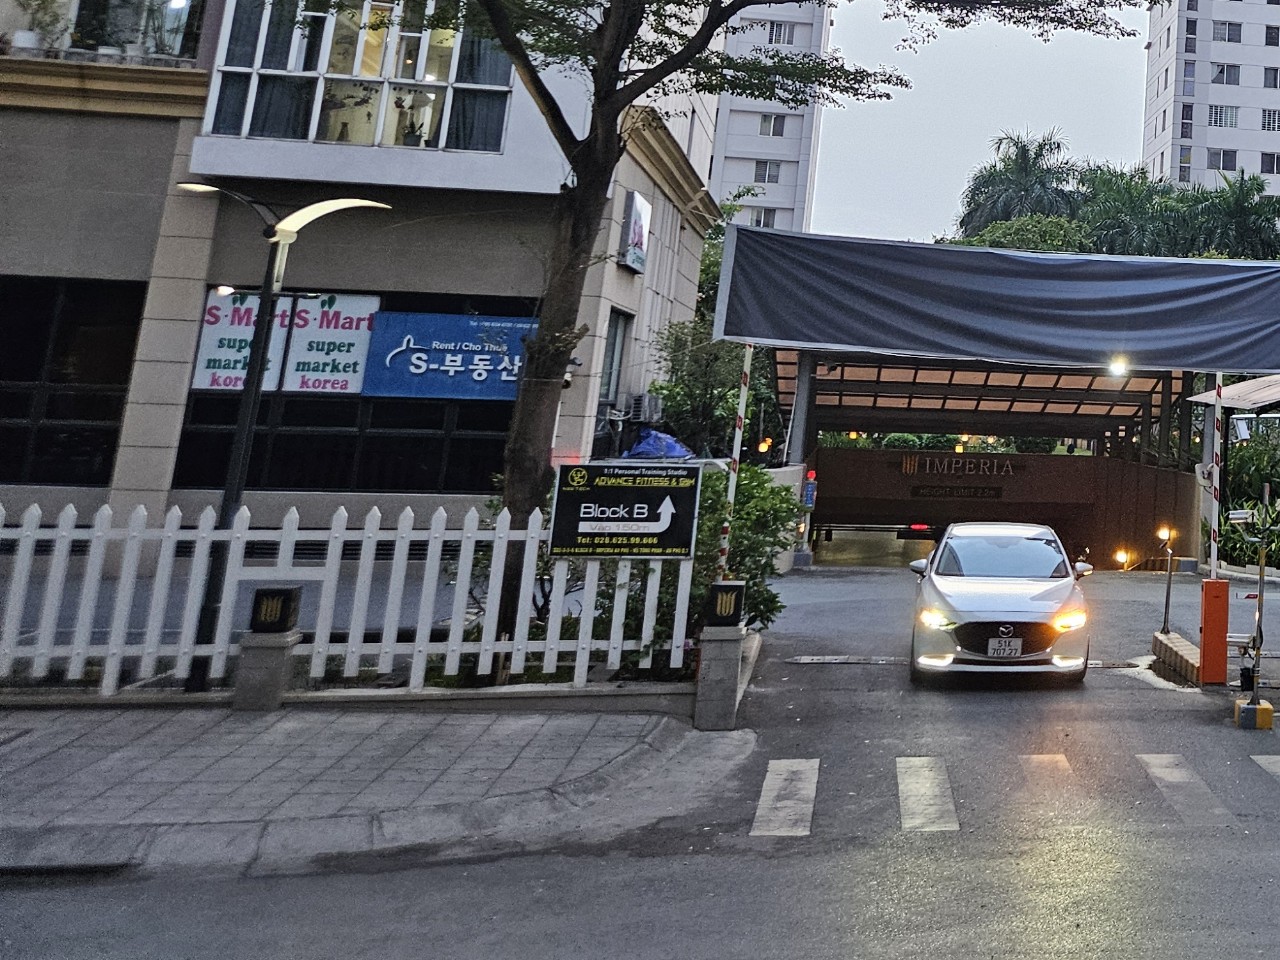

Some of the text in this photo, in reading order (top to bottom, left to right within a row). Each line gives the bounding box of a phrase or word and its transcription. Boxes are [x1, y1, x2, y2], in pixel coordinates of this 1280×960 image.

[218, 337, 253, 352] sup
[307, 340, 355, 355] super
[432, 341, 455, 350] Rent
[462, 342, 482, 351] Cho
[295, 359, 360, 374] market
[210, 372, 247, 387] kor
[300, 375, 349, 390] korea
[641, 468, 666, 476] Training
[925, 457, 1014, 475] IMPERIA
[580, 503, 648, 518] Block B
[615, 523, 650, 532] 150m
